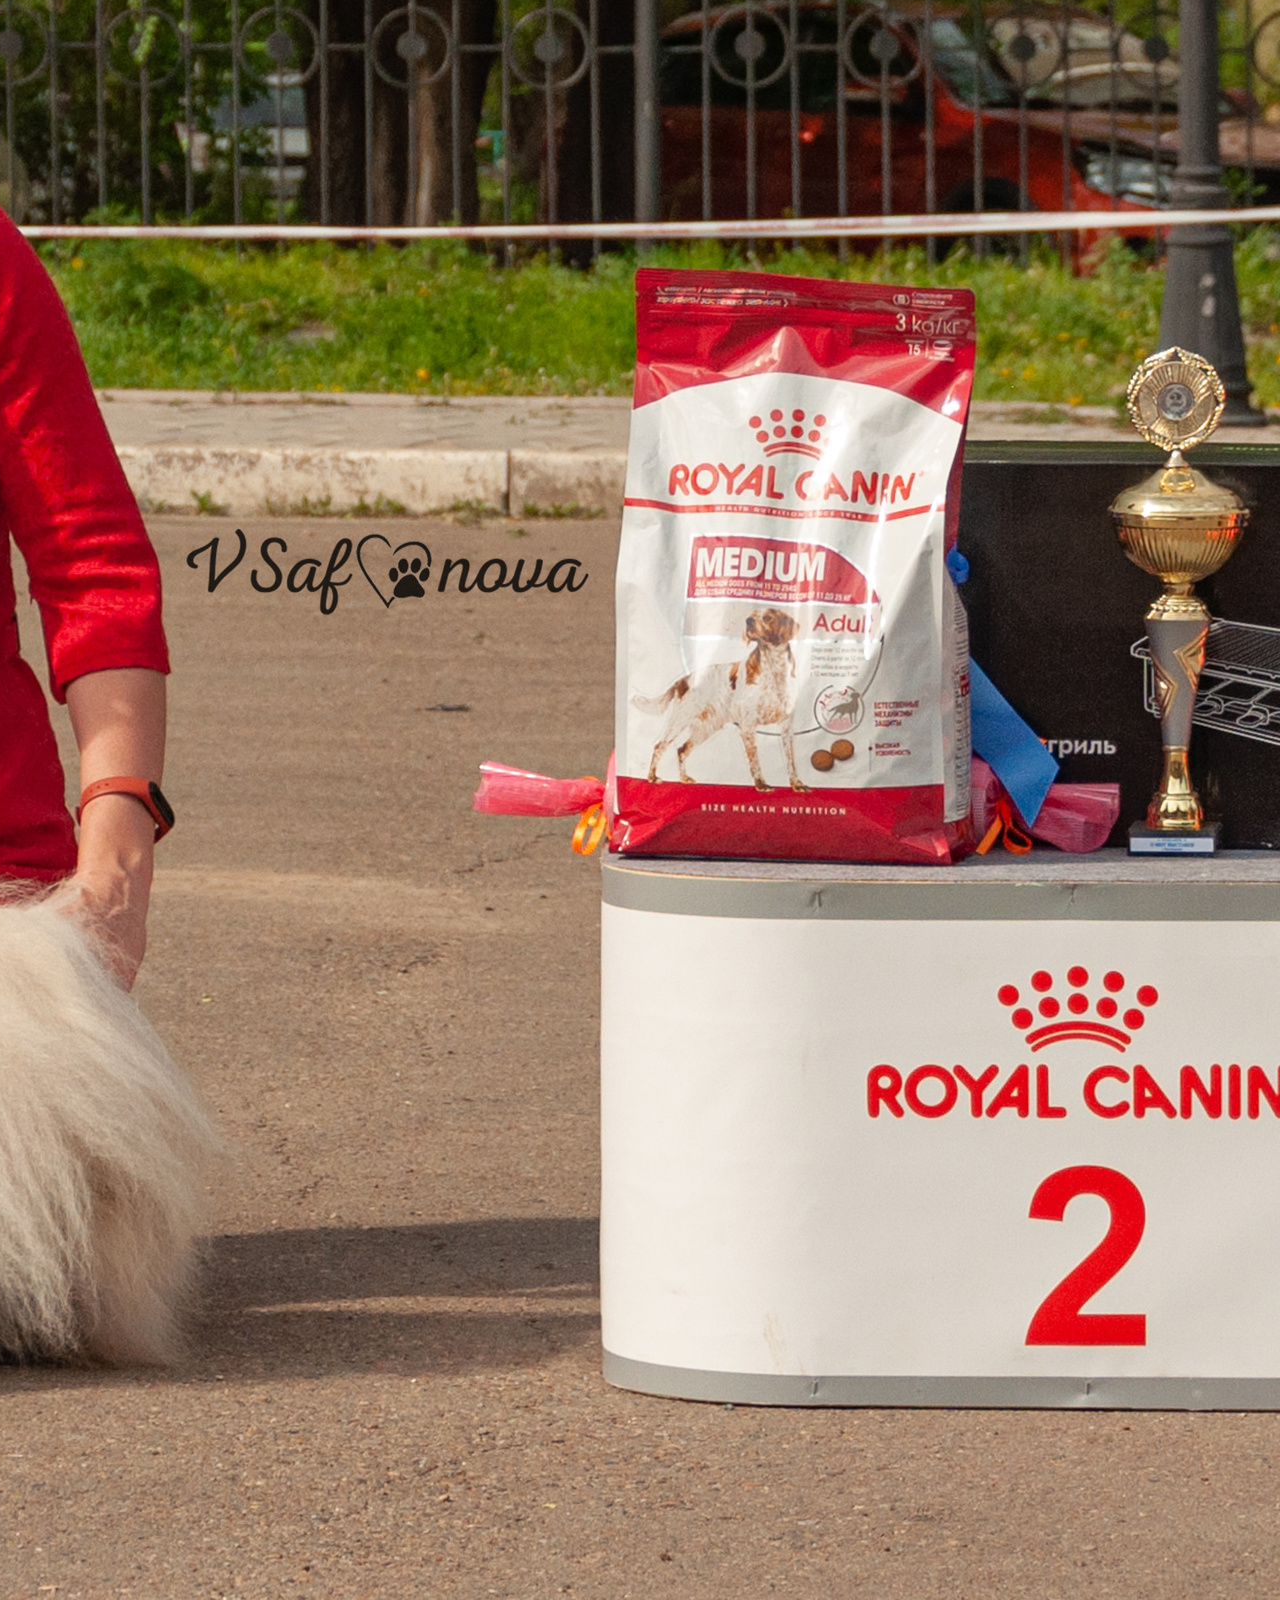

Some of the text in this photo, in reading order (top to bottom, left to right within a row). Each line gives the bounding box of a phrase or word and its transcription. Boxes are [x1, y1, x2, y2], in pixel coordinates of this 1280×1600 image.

[895, 313, 906, 332] 3
[908, 343, 921, 356] 15
[668, 462, 916, 506] ROYAL CANIN
[695, 546, 826, 582] MEDIUM
[700, 803, 847, 816] SIZE HEALTH NUTRITION
[867, 1064, 1280, 1120] ROYAL CANIN
[1025, 1165, 1147, 1346] 2
